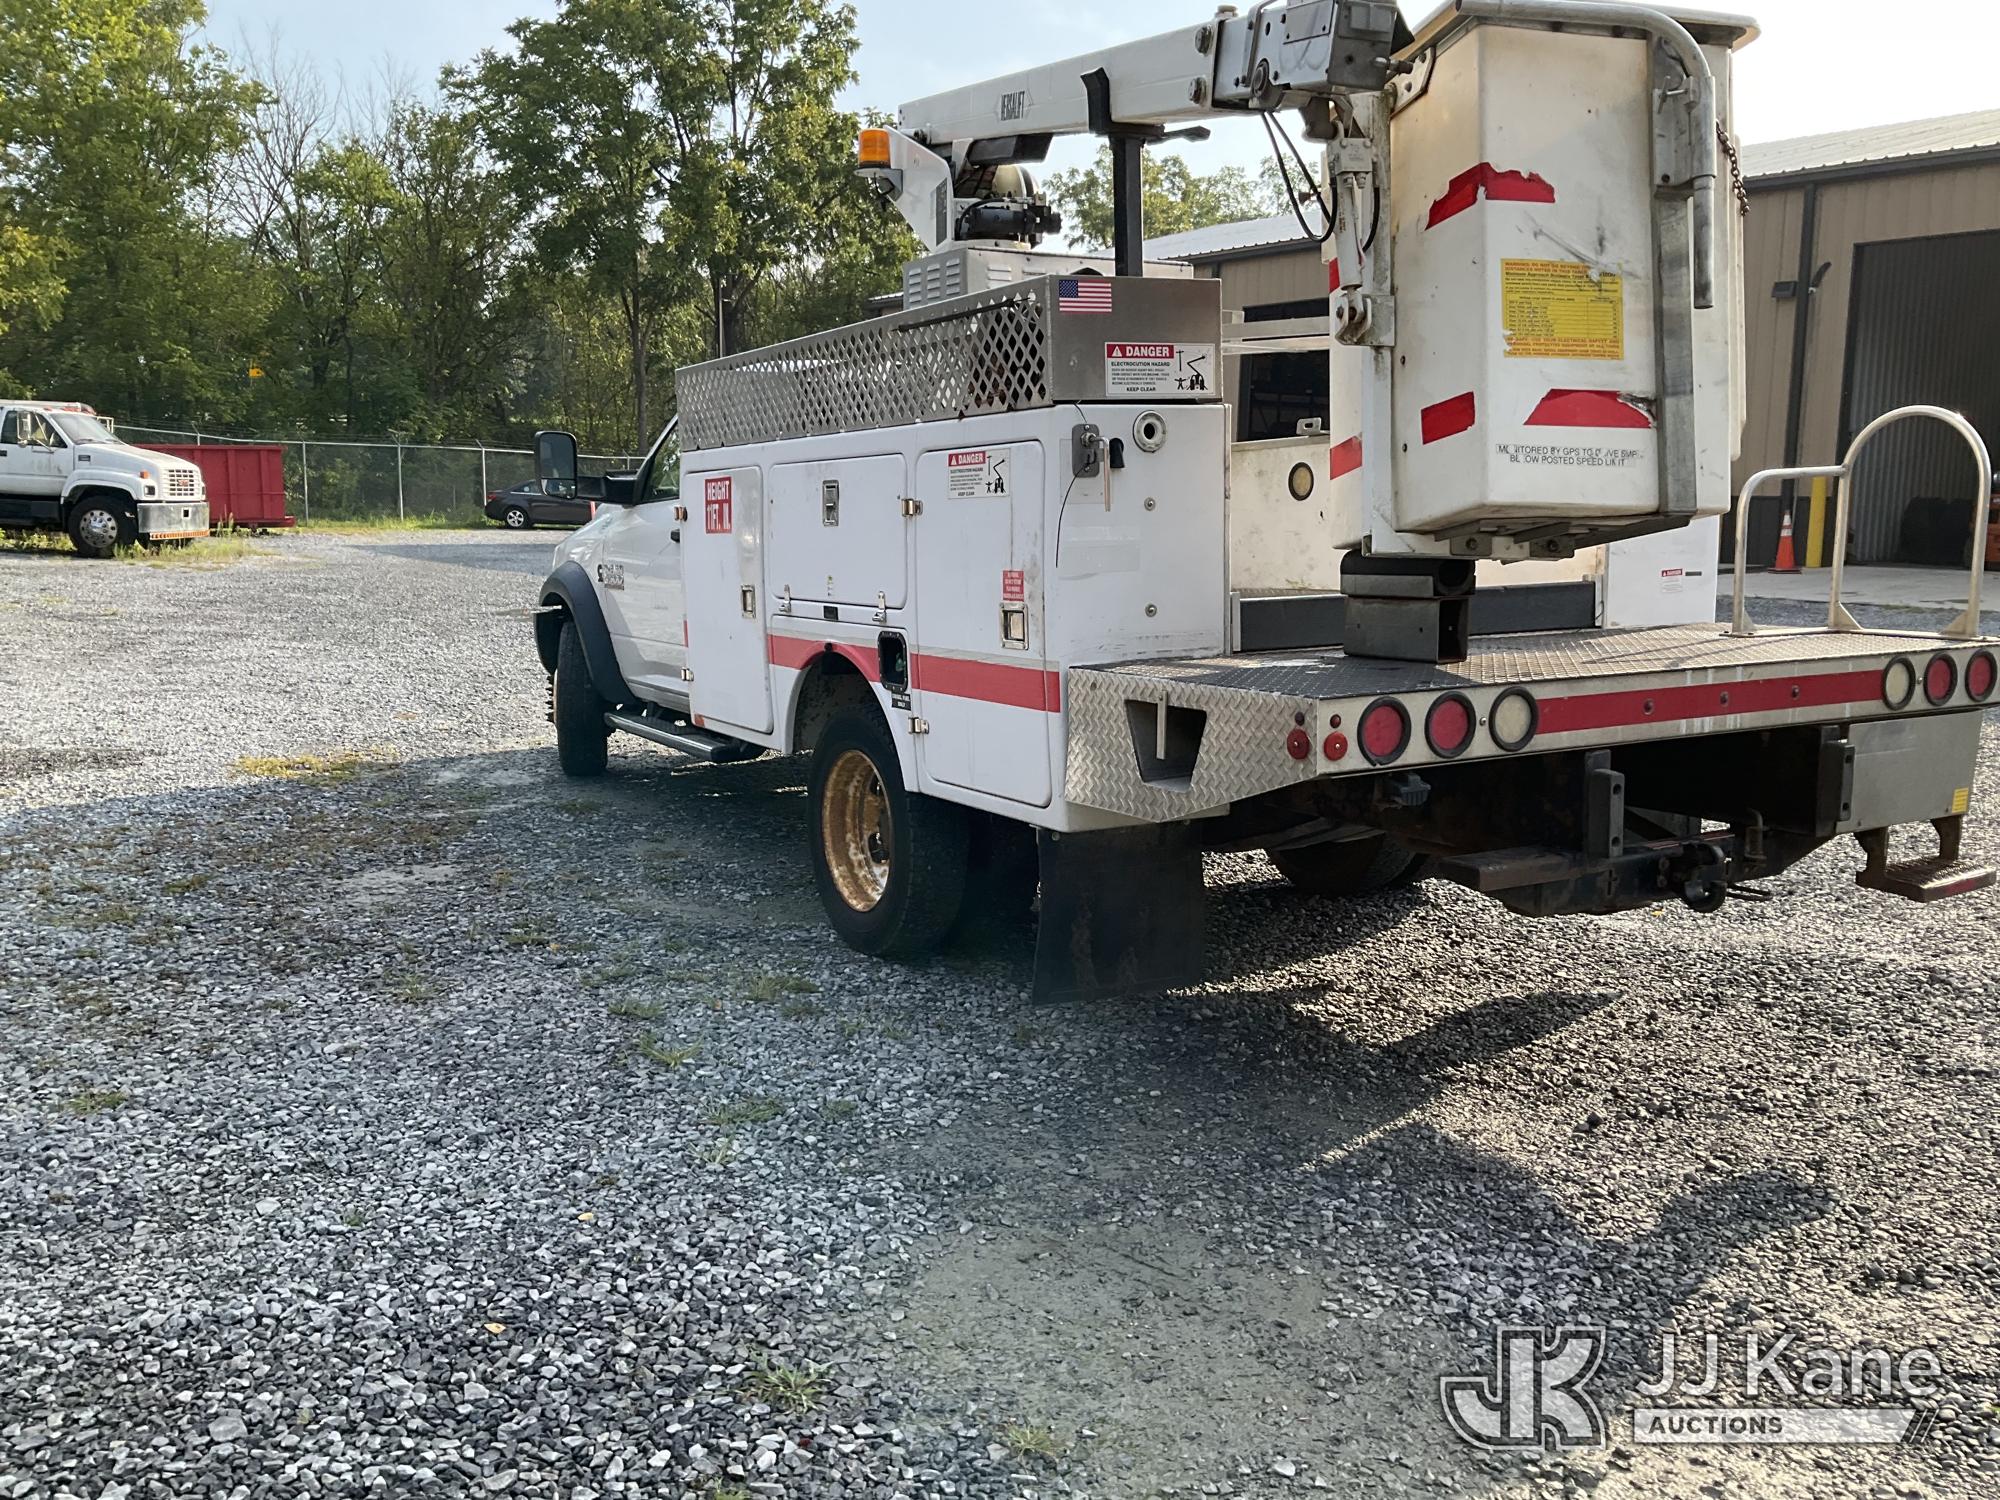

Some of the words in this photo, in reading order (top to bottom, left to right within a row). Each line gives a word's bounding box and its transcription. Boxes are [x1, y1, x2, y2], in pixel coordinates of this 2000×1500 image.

[1125, 346, 1170, 357] DANGER
[1498, 445, 1548, 455] MITORED
[1550, 446, 1560, 455] BY
[1562, 447, 1580, 456] GPS
[1582, 448, 1593, 456] TO
[1594, 448, 1619, 458] DIVE
[958, 452, 984, 465] DANGER
[1541, 455, 1575, 465] POSTED
[1576, 457, 1604, 466] SPEED
[707, 480, 729, 501] HEIGHT
